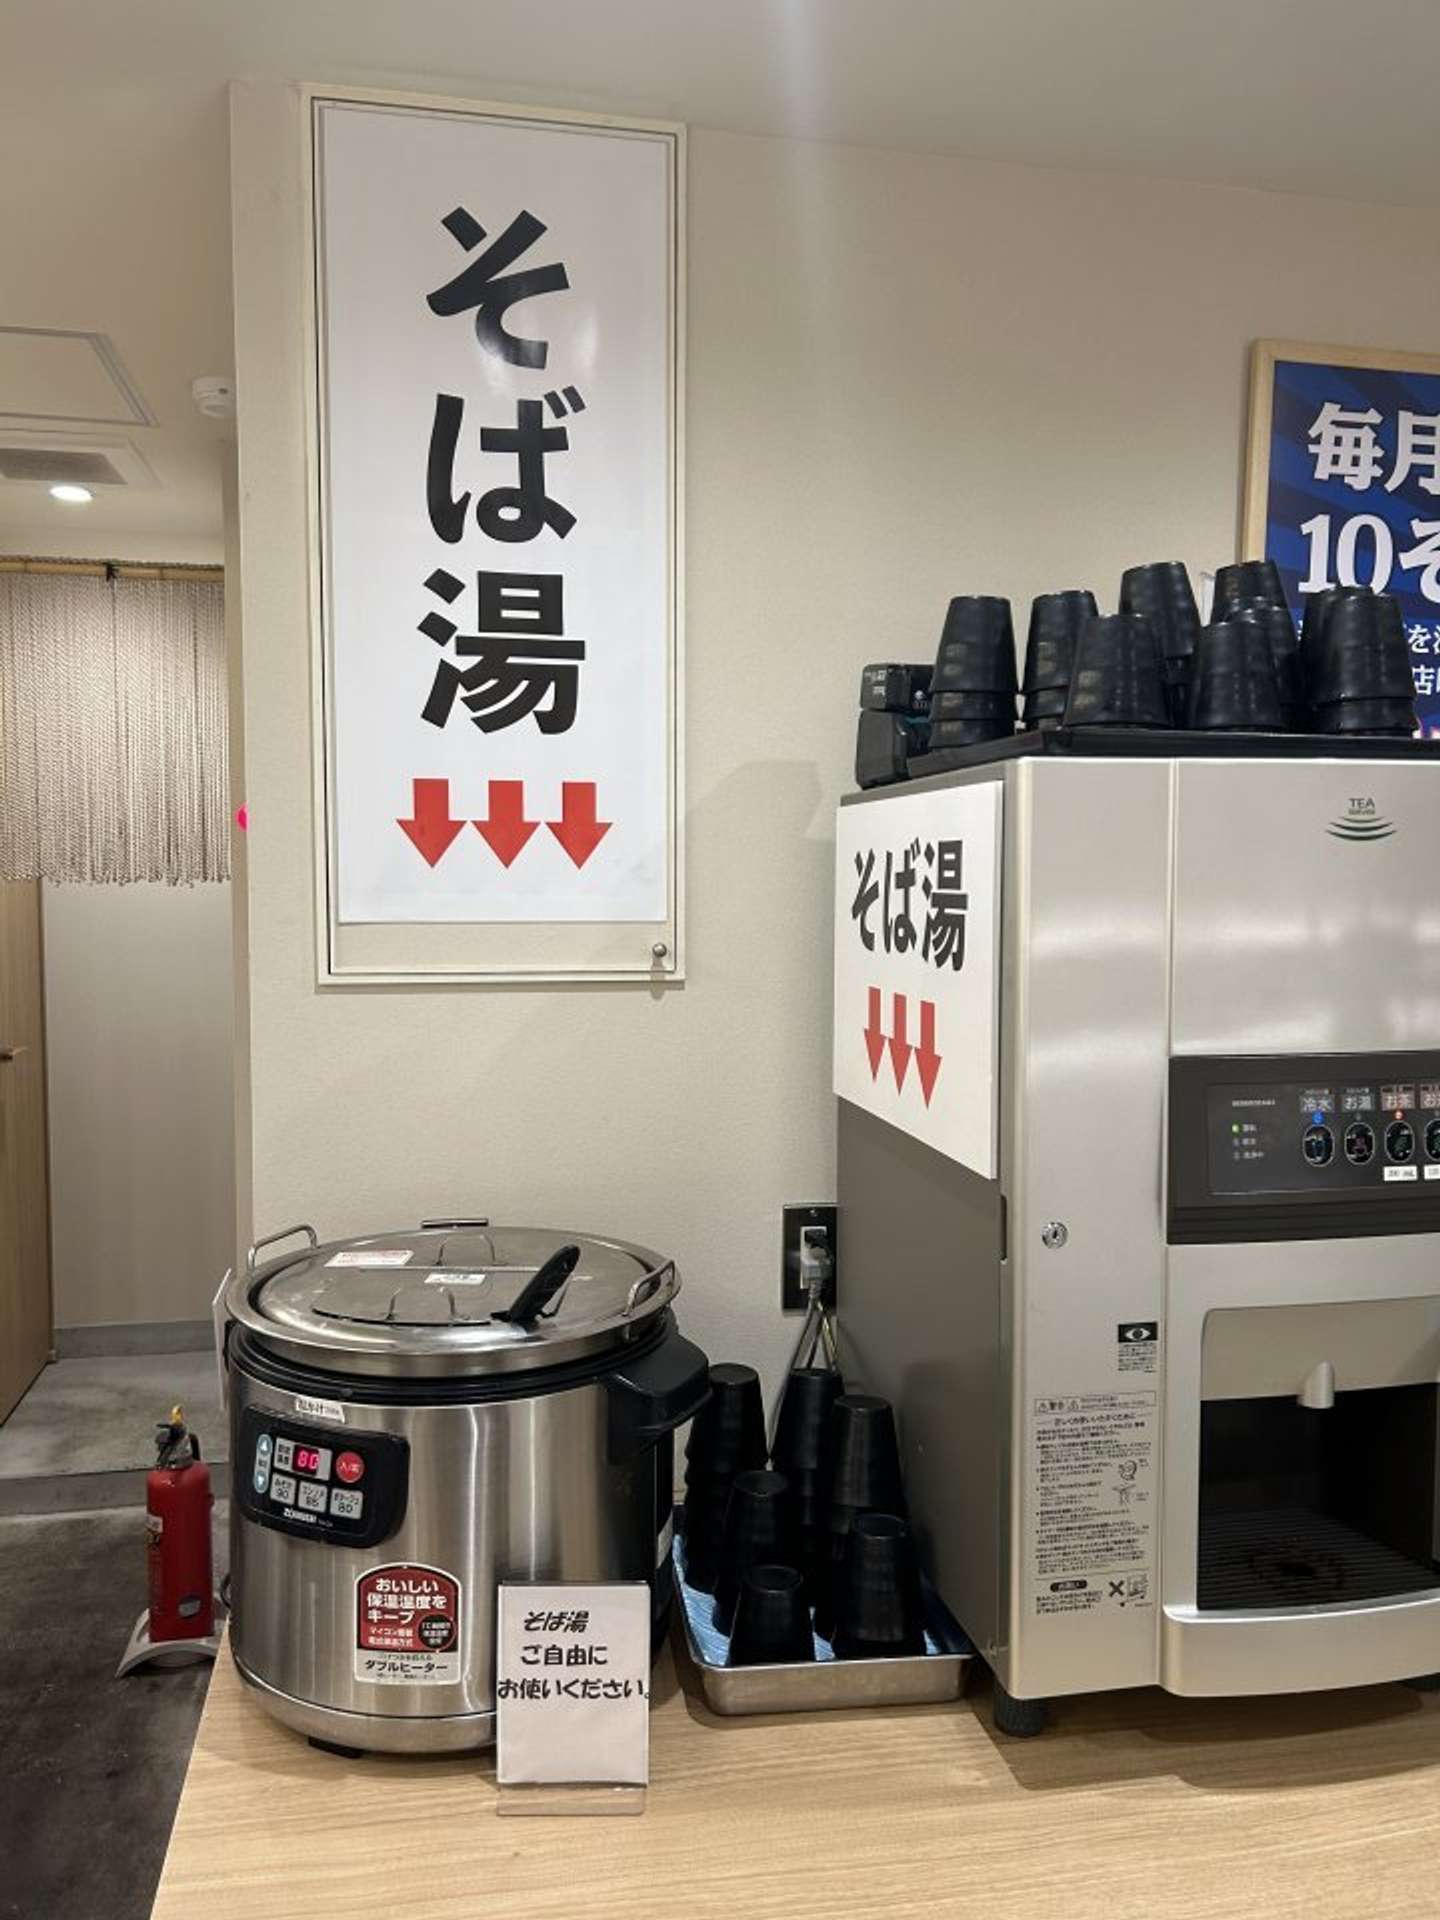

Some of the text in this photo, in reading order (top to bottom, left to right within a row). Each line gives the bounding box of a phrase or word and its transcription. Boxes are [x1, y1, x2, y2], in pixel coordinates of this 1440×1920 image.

[1307, 402, 1440, 495] 毎月
[417, 206, 586, 735] そば湯
[1348, 797, 1376, 808] TEA
[851, 837, 968, 972] そば湯
[375, 1578, 439, 1593] おいしい
[367, 1592, 448, 1610] 保温温度を
[367, 1608, 416, 1625] キープ
[523, 1610, 590, 1633] そば湯
[365, 1659, 449, 1673] ダブルヒーター
[520, 1644, 609, 1667] ご自由に
[497, 1678, 651, 1700] お使いください。
